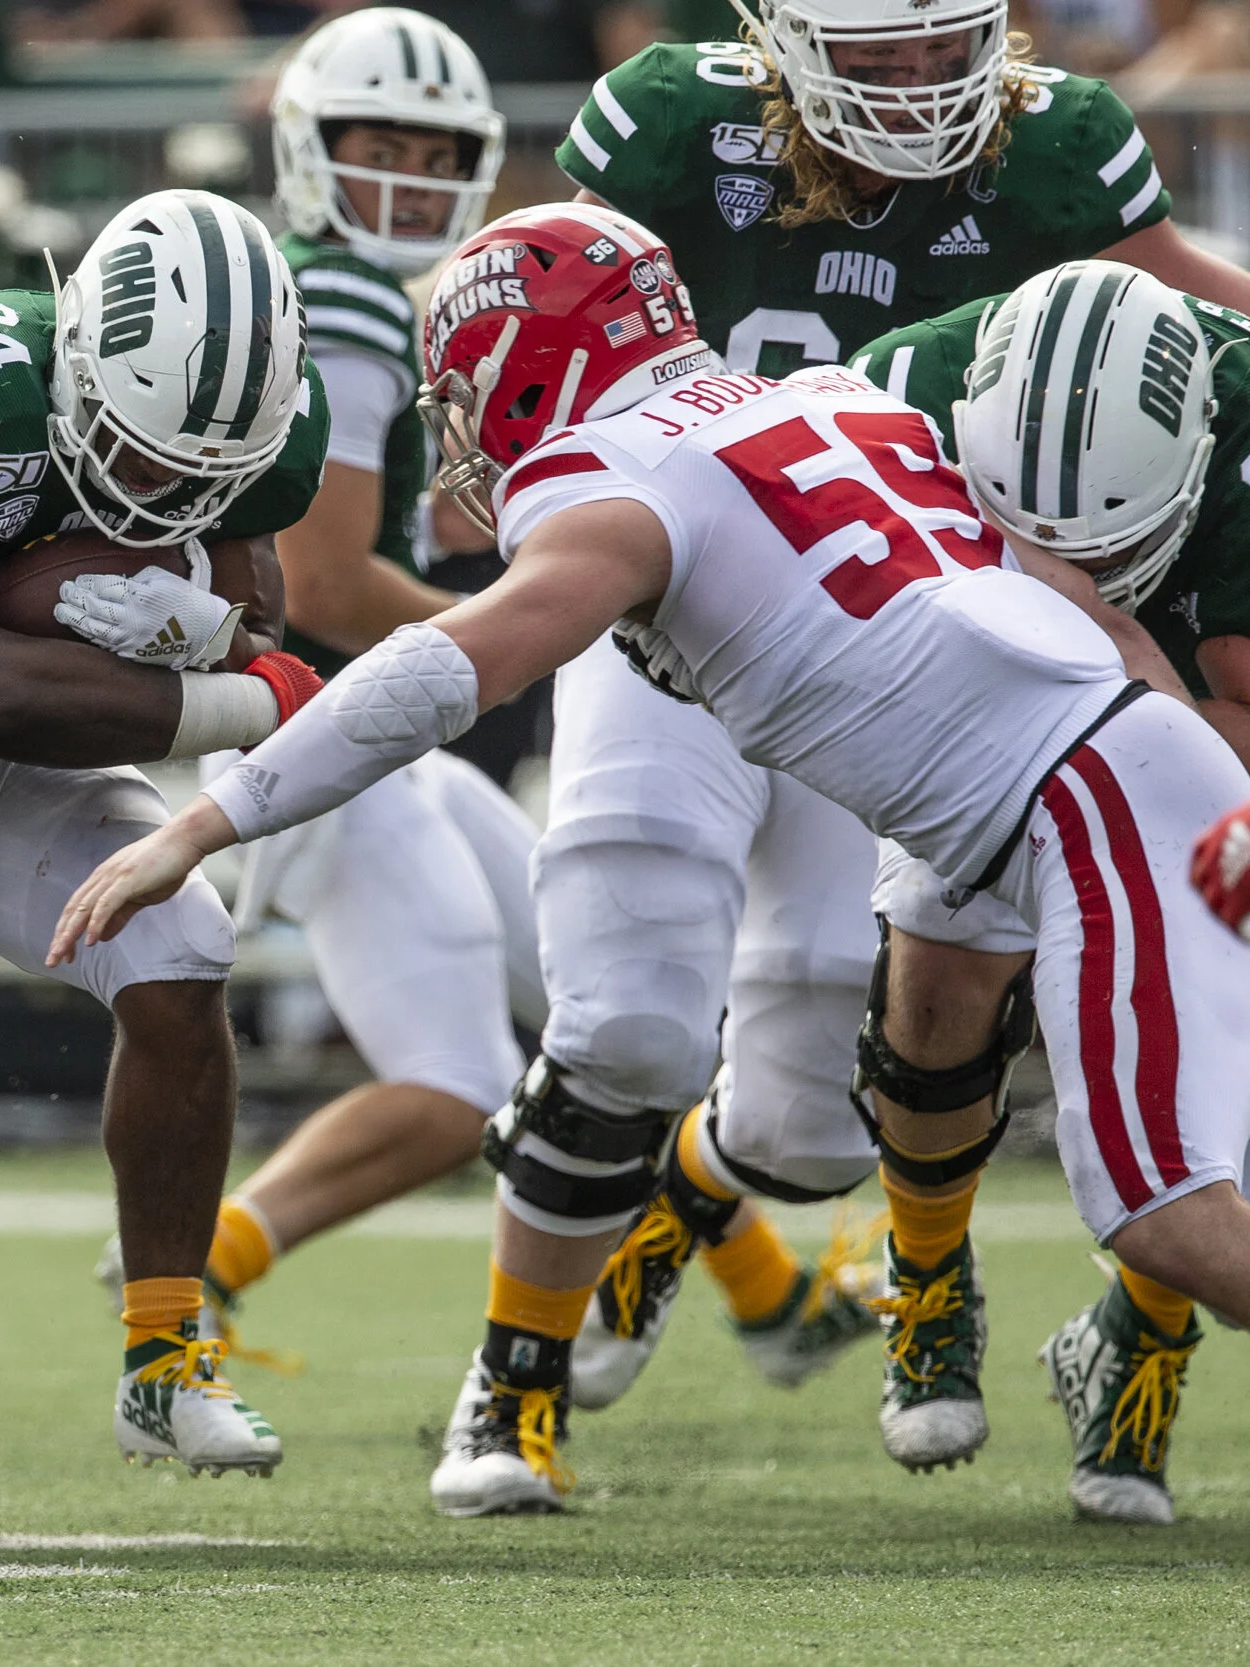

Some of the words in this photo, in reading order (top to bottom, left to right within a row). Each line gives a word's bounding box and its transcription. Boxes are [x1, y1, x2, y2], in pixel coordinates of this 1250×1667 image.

[584, 238, 617, 263] 36
[929, 241, 991, 256] adidas
[99, 241, 156, 360] OHIO
[814, 251, 897, 307] OHIO
[646, 284, 695, 336] 59
[1138, 312, 1198, 438] OHIO
[640, 411, 700, 437] J.
[714, 411, 1004, 620] 59
[135, 640, 192, 657] adidas
[235, 769, 271, 813] adidas
[122, 1399, 179, 1451] adida
